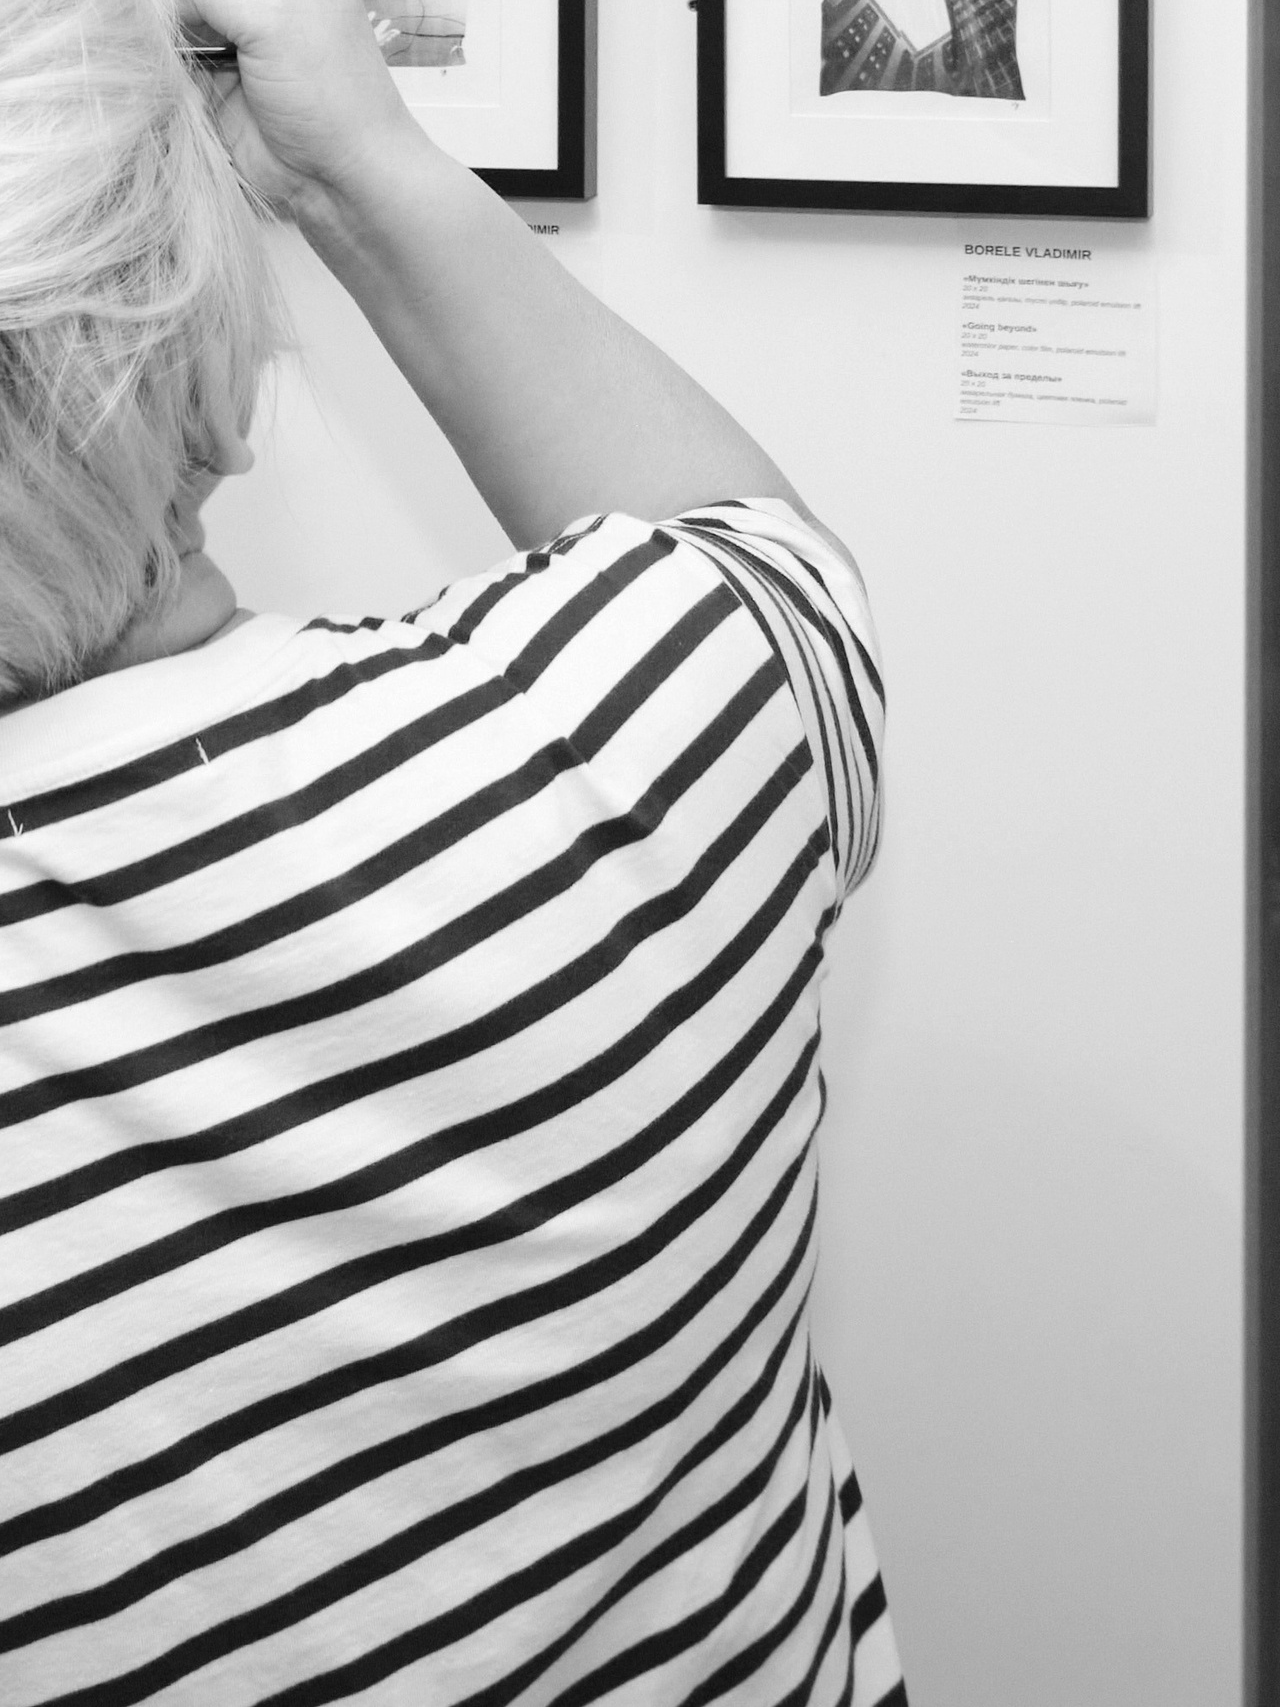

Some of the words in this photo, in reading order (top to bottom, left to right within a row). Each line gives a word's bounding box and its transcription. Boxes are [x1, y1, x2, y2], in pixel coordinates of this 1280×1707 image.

[964, 244, 1021, 257] BORELE
[1026, 247, 1092, 260] VLADIMIR
[962, 322, 994, 332] «Going
[998, 324, 1036, 333] beyond»
